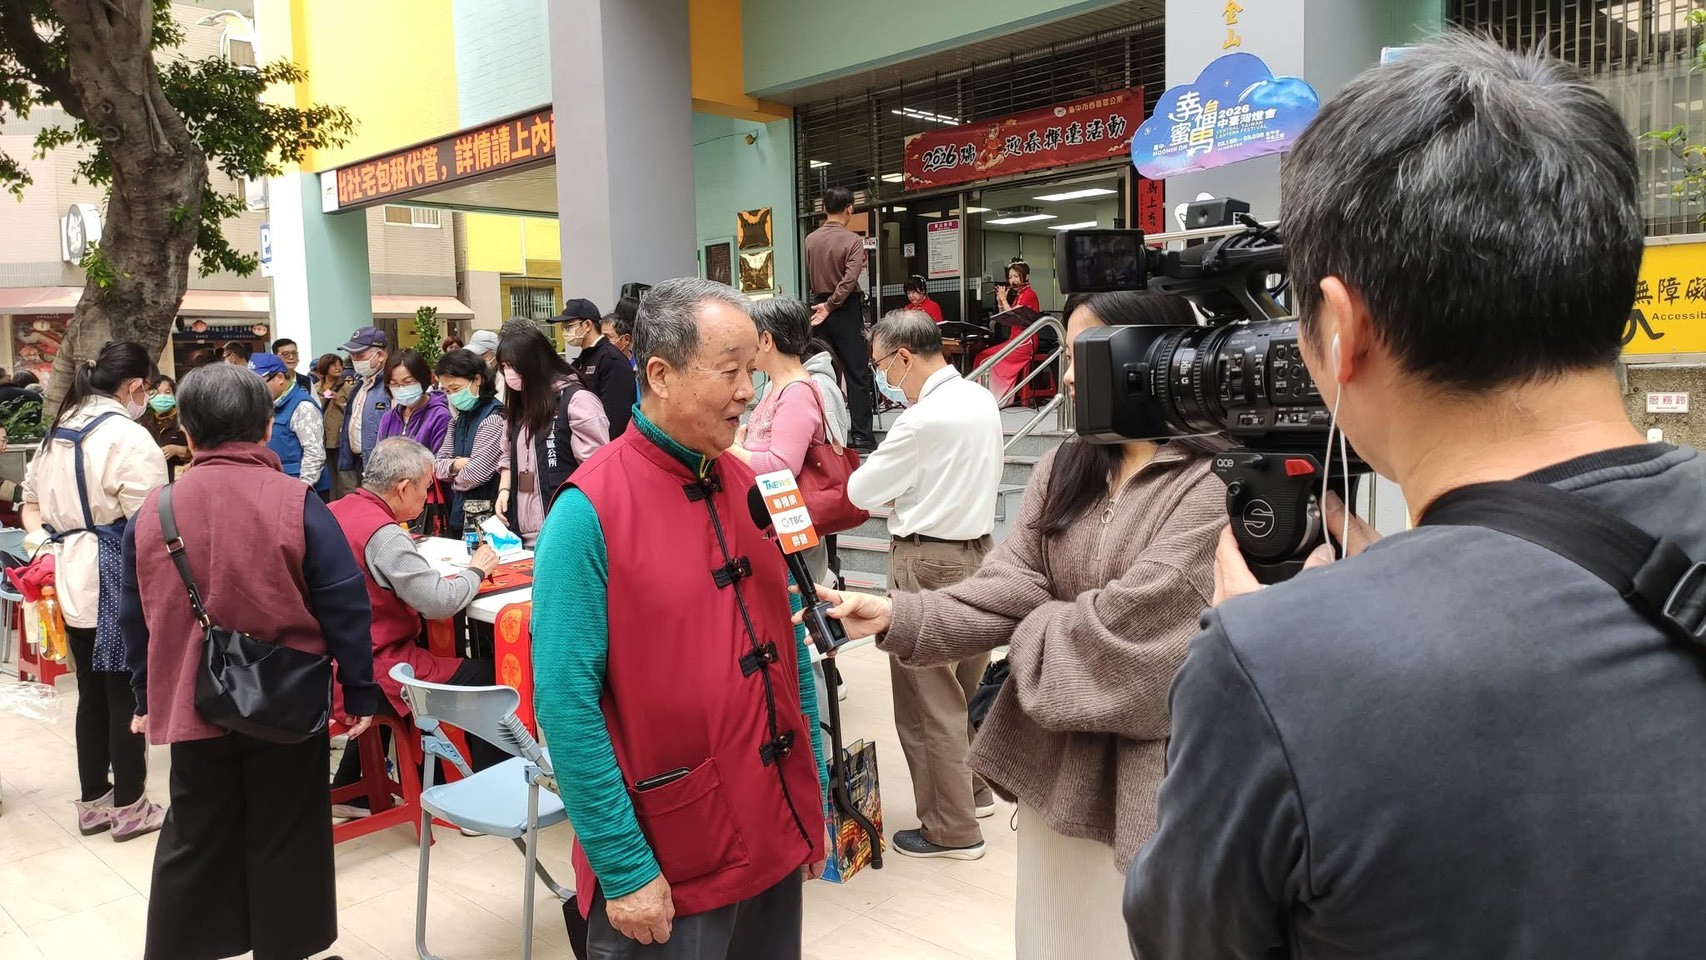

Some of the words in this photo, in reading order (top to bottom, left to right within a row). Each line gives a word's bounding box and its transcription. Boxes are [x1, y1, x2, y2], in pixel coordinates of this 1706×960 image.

[1222, 0, 1243, 49] 金山
[1218, 104, 1250, 119] 2026
[922, 147, 957, 172] 2026
[959, 143, 977, 165] 瑞
[1216, 458, 1235, 468] ace
[763, 478, 792, 490] TNEWS
[789, 514, 804, 525] TBC
